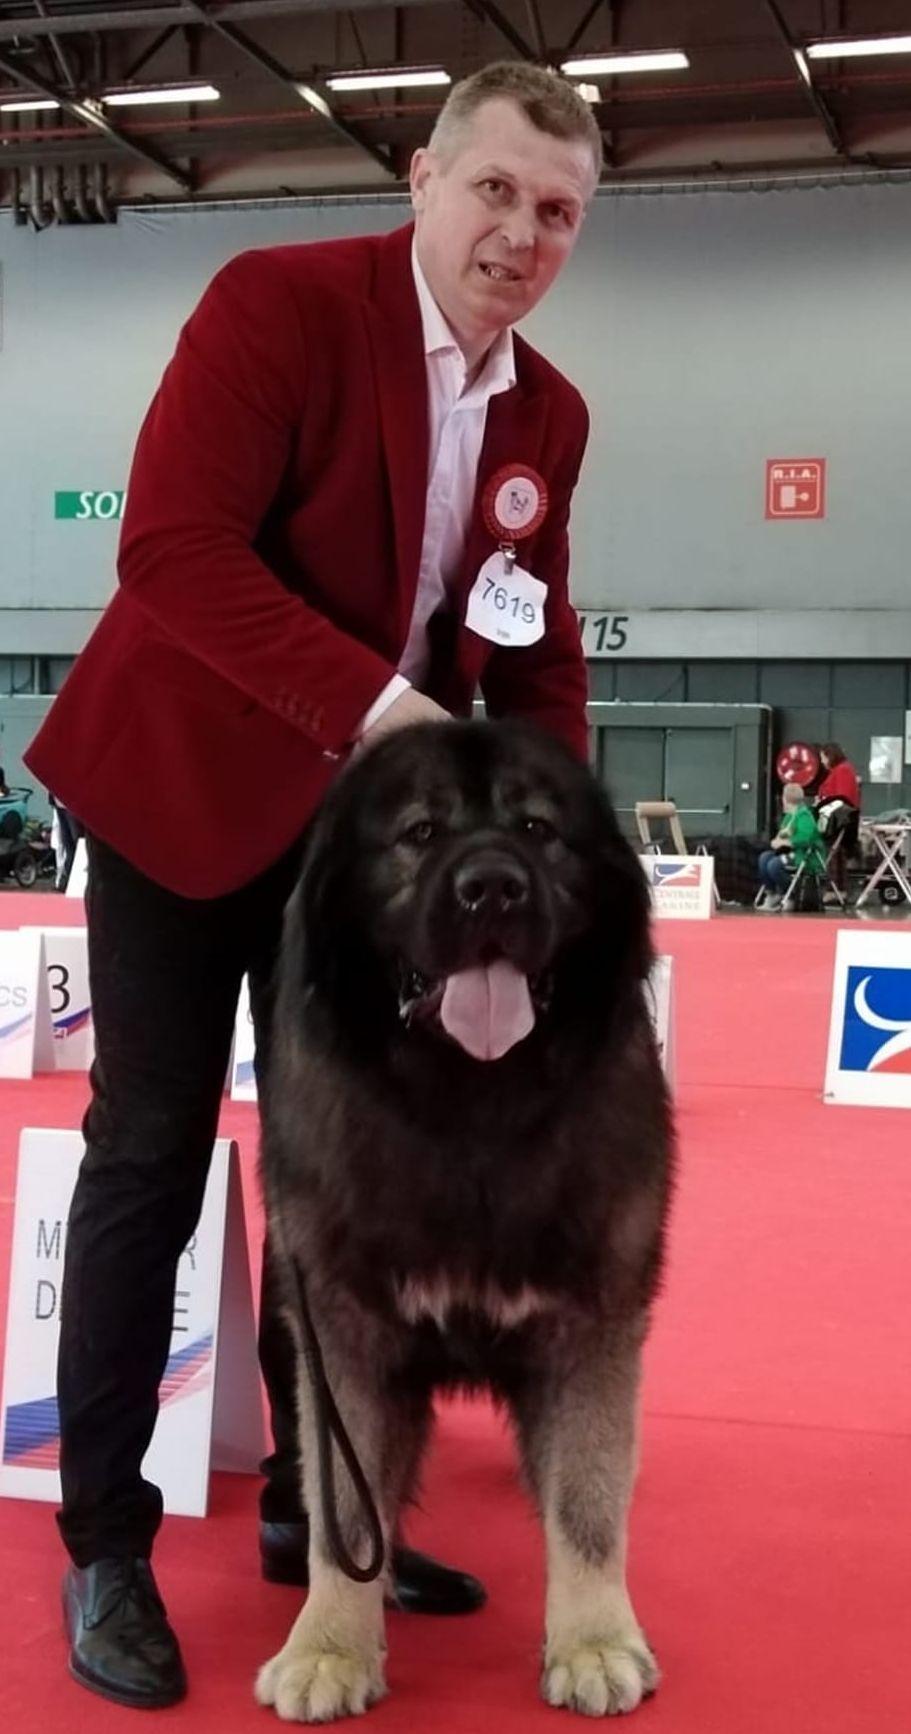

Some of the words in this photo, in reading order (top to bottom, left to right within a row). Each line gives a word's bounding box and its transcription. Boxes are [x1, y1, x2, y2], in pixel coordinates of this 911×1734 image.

[76, 491, 126, 519] SO
[483, 577, 535, 623] 7619
[47, 964, 71, 1014] 3
